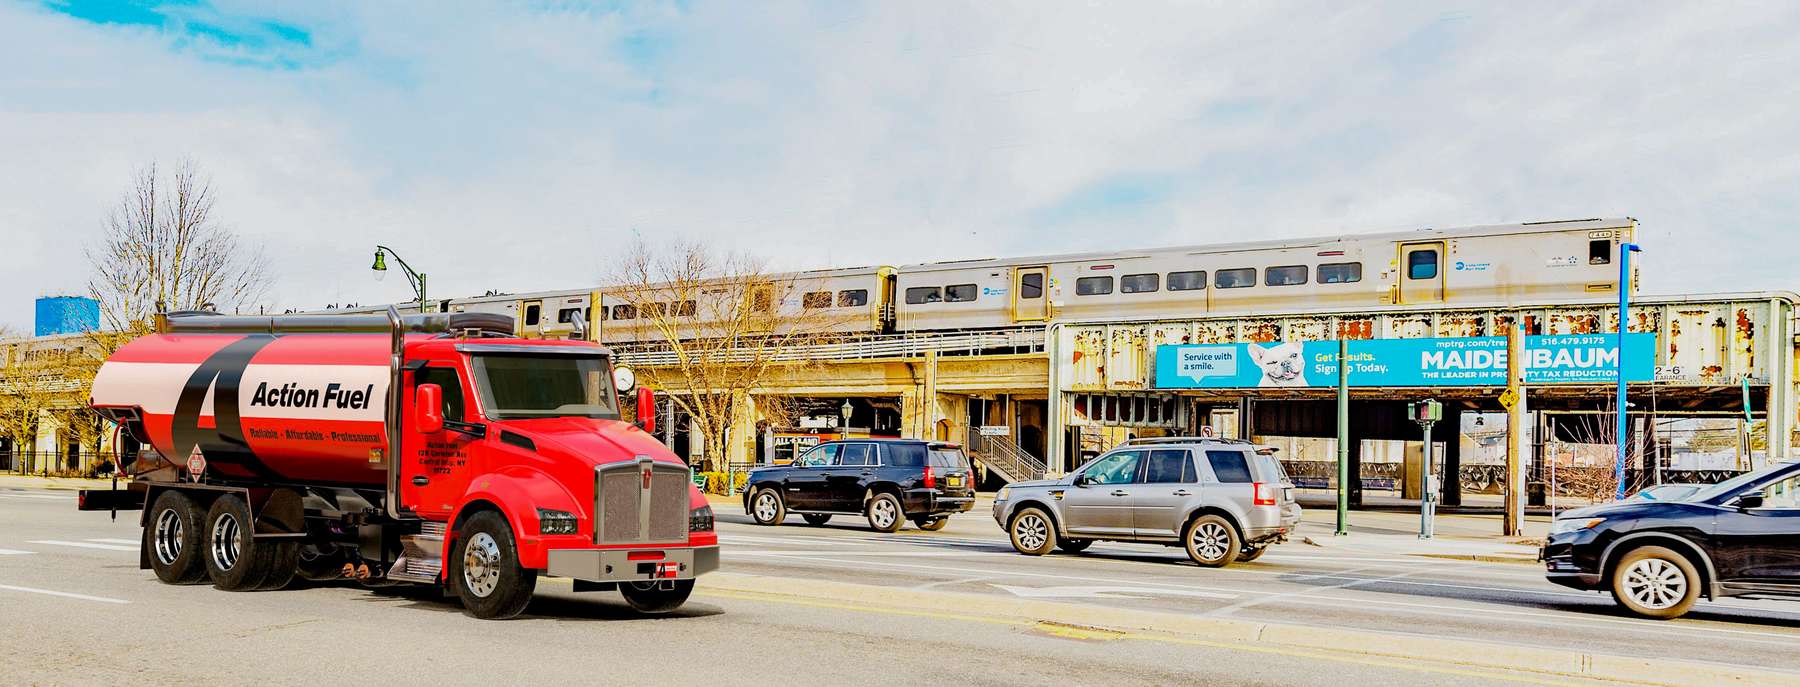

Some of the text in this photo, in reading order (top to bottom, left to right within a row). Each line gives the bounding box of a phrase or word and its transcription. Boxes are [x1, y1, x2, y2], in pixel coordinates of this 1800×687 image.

[1541, 337, 1605, 346] 516.479.9175
[1184, 352, 1233, 361] Service with
[1315, 352, 1376, 362] Get Rsults.
[1421, 347, 1619, 370] MAIDEBAUM
[1190, 362, 1214, 370] smile.
[1315, 363, 1337, 375] Sign
[1355, 363, 1389, 374] Today.
[1441, 371, 1477, 379] LEADER
[1490, 370, 1539, 378] PROTY
[1543, 370, 1561, 378] TAX
[250, 381, 374, 410] Action Fuel
[285, 429, 323, 441] Affordable
[330, 431, 381, 443] Professional
